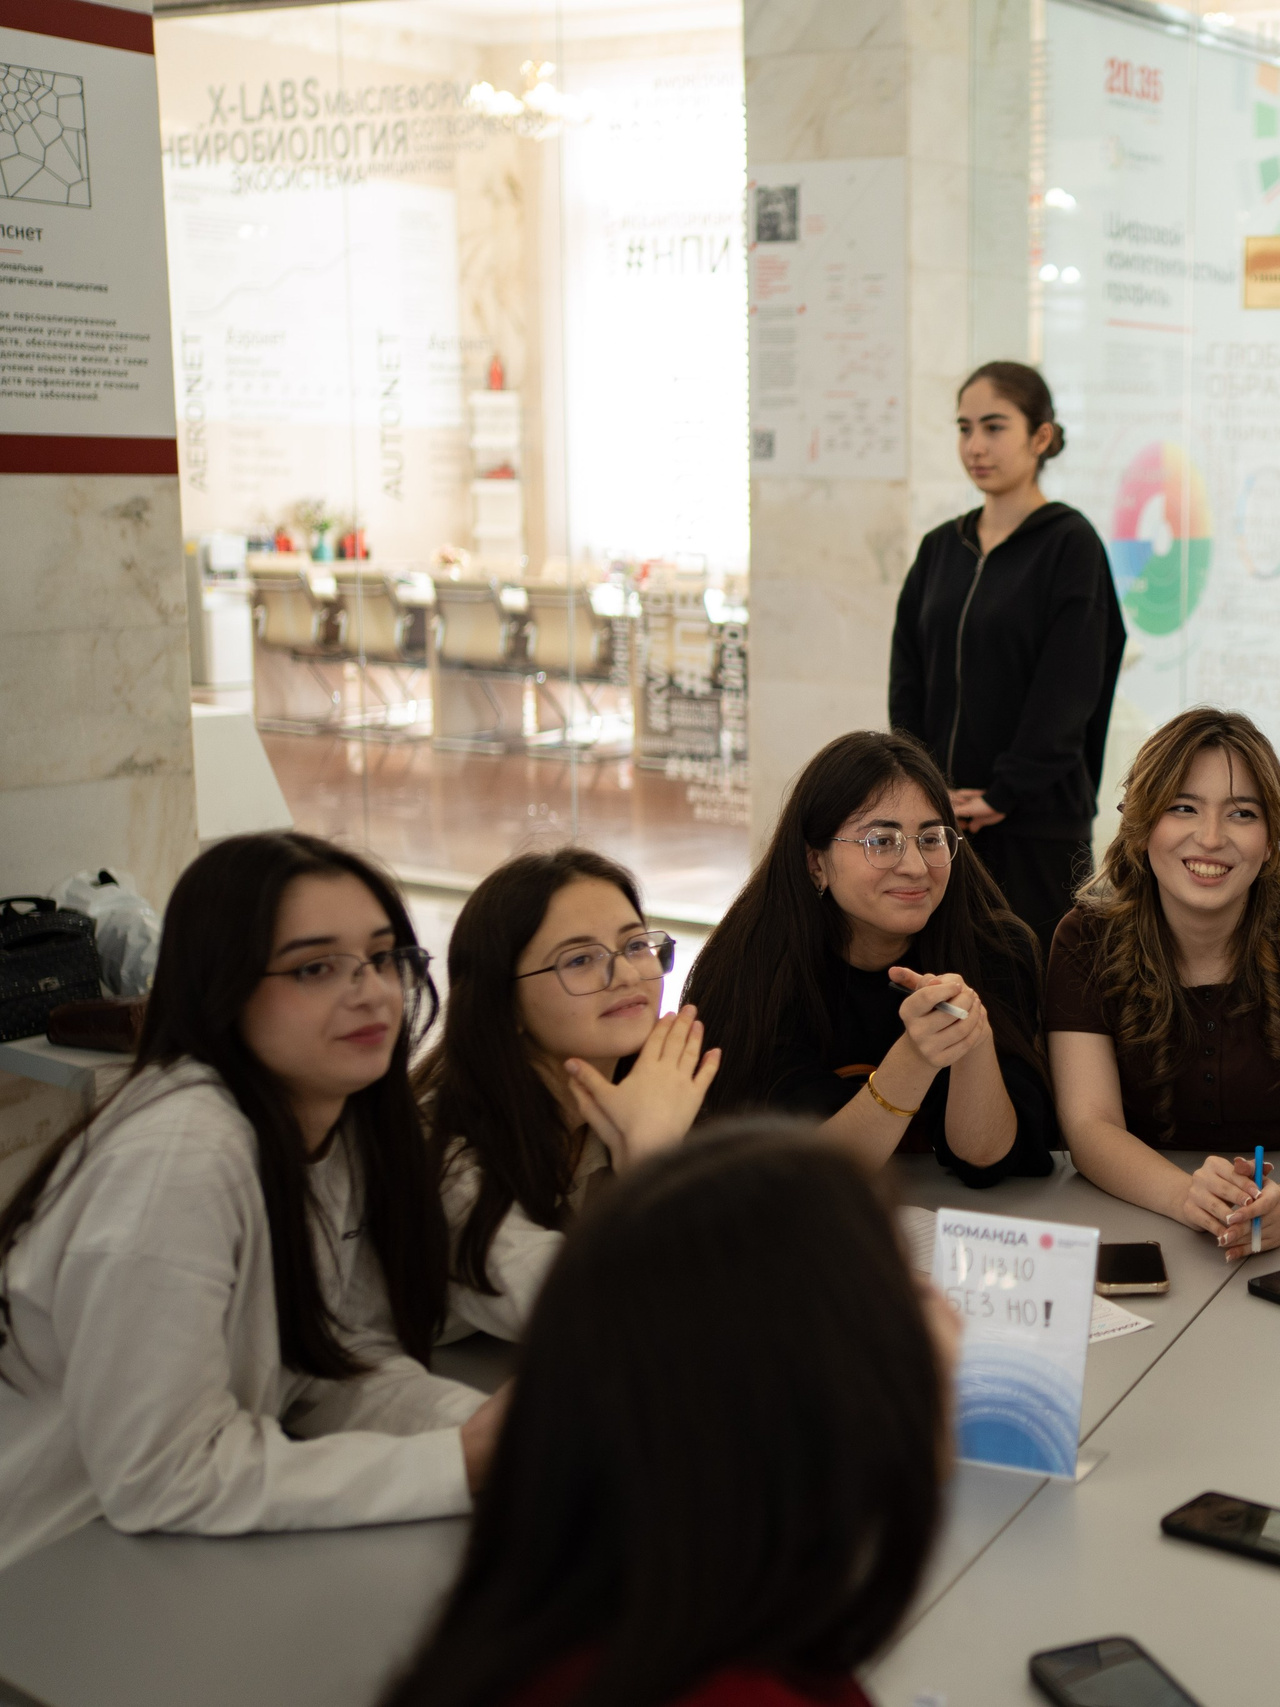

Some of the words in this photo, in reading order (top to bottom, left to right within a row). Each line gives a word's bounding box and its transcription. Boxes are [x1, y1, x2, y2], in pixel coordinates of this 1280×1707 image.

[207, 78, 320, 127] X-LABS
[323, 81, 472, 117] МЫСЛЕФОРМ
[161, 117, 411, 171] НЕЙРОБИОЛОГИЯ
[230, 165, 367, 196] ЭКОСИСТЕМА
[181, 328, 208, 494] AERONET
[377, 327, 405, 502] AUTONET
[942, 1221, 1029, 1248] КОМАНДА
